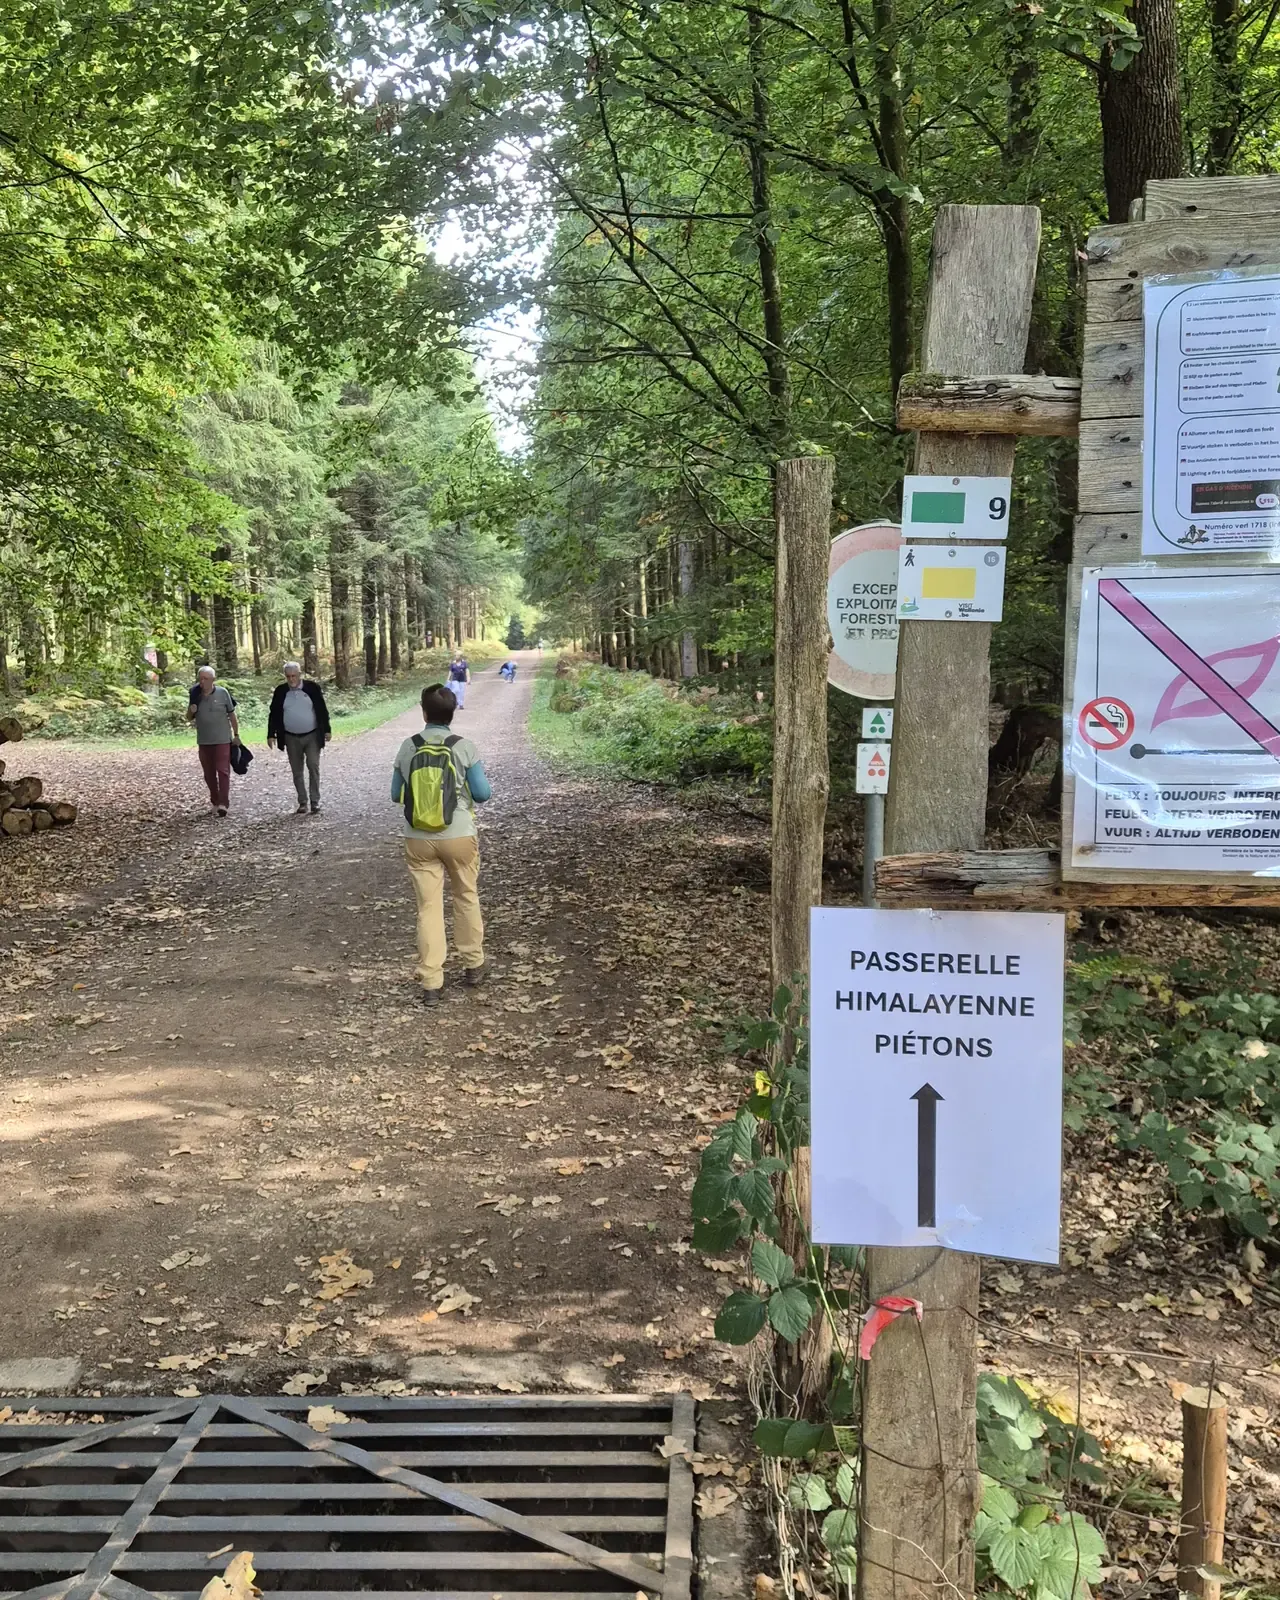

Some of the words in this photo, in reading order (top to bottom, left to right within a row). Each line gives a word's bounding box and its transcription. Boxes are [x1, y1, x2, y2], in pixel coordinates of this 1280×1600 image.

[989, 497, 1007, 520] 9
[841, 613, 900, 624] FORESTI
[1105, 791, 1140, 800] FEX
[1155, 791, 1226, 801] TOUJOURS
[1105, 827, 1142, 837] VUUR
[1155, 829, 1201, 838] ALTIJD
[1207, 829, 1280, 838] VERBODEN
[850, 951, 1021, 975] PASSERELLE
[836, 990, 1035, 1017] HIMALAYENNE
[875, 1030, 993, 1058] PIÉTONS
